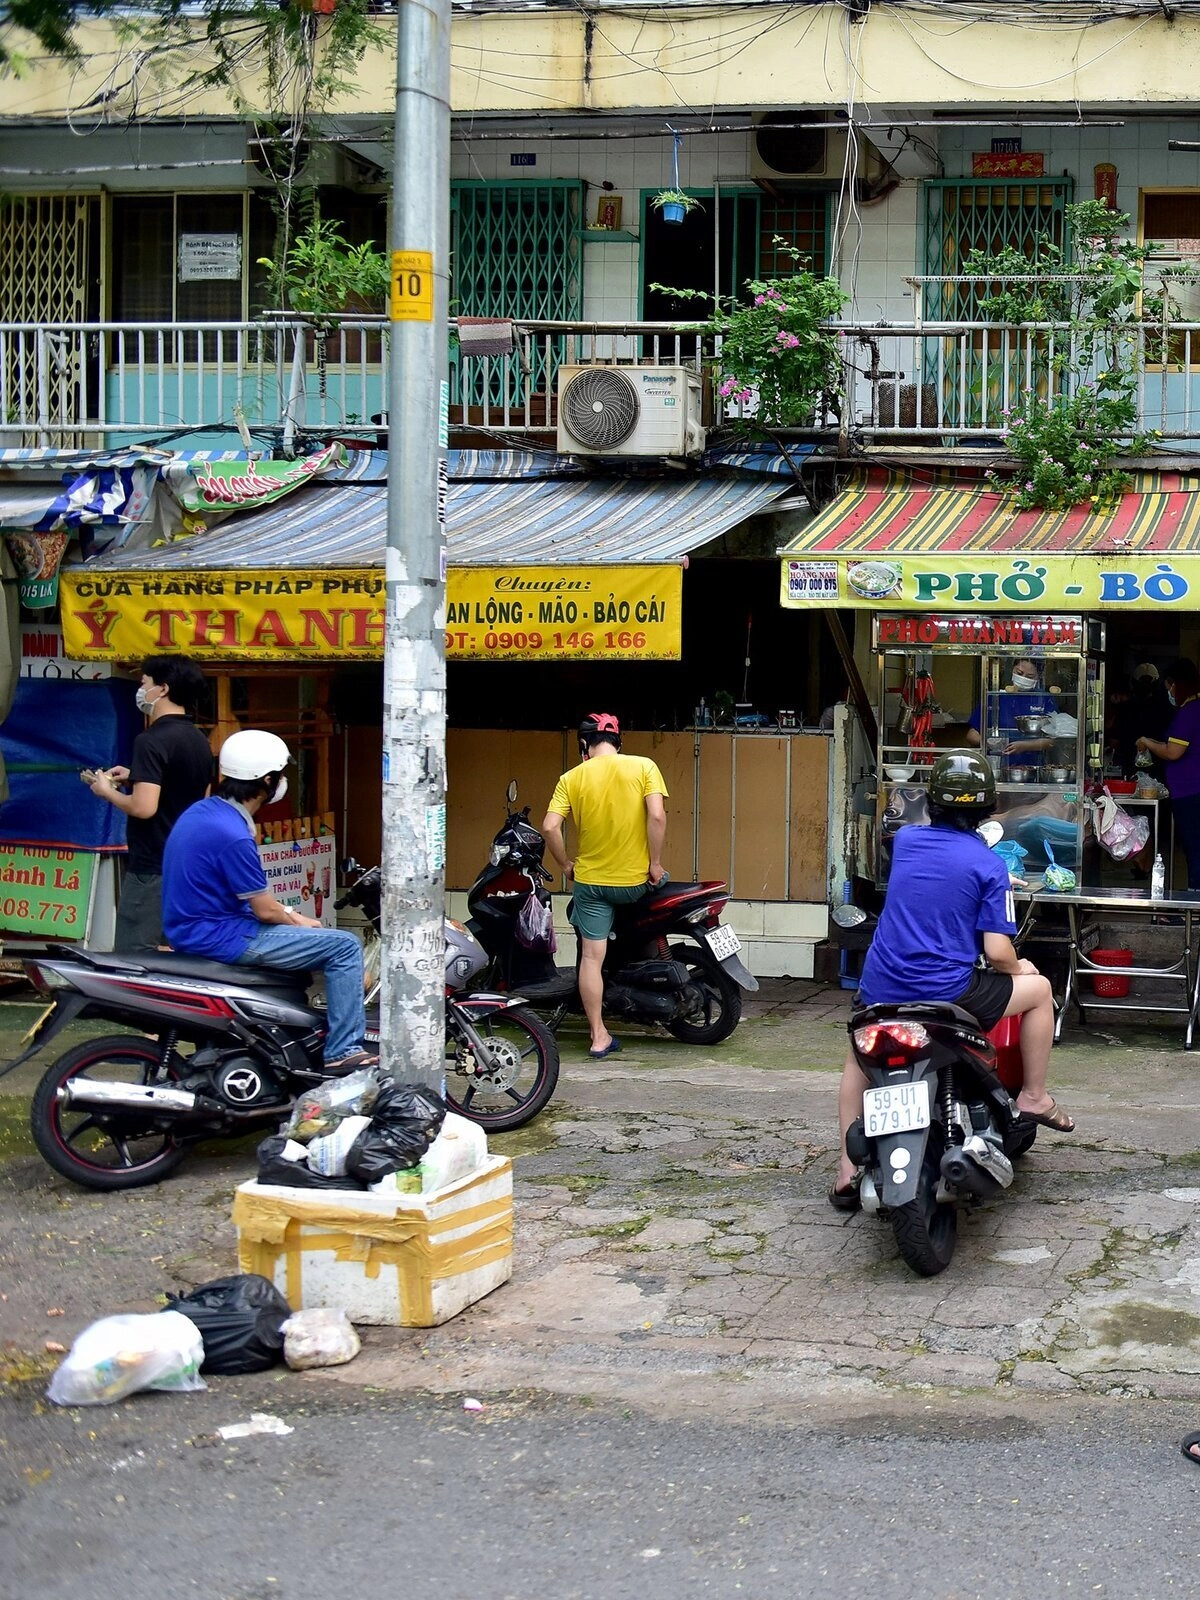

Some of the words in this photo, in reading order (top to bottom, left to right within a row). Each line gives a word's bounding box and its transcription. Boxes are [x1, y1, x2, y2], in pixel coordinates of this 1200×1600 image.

[395, 273, 421, 297] 10
[234, 576, 312, 596] PHÁP
[323, 578, 386, 599] PHỤ
[494, 575, 591, 592] Chuyên:
[790, 579, 807, 590] 0907
[809, 579, 822, 590] 000
[824, 579, 837, 590] 875
[819, 571, 836, 579] NAM
[913, 560, 1047, 602] PHỞ
[1099, 564, 1188, 602] BÒ
[73, 599, 115, 649] Ý
[475, 597, 523, 630] LỘNG
[538, 595, 578, 624] MÃO
[594, 593, 631, 624] BẢO
[634, 595, 666, 624] CÁI
[484, 632, 543, 650] 0909
[553, 632, 595, 650] 146
[604, 632, 647, 649] 166
[949, 618, 1024, 644] THANH
[1031, 615, 1076, 644] TÂM
[0, 862, 46, 887] ánh
[53, 868, 80, 890] Lá
[0, 898, 77, 924] 08.773
[874, 1086, 916, 1111] 59-U1
[869, 1106, 925, 1132] 679.14
